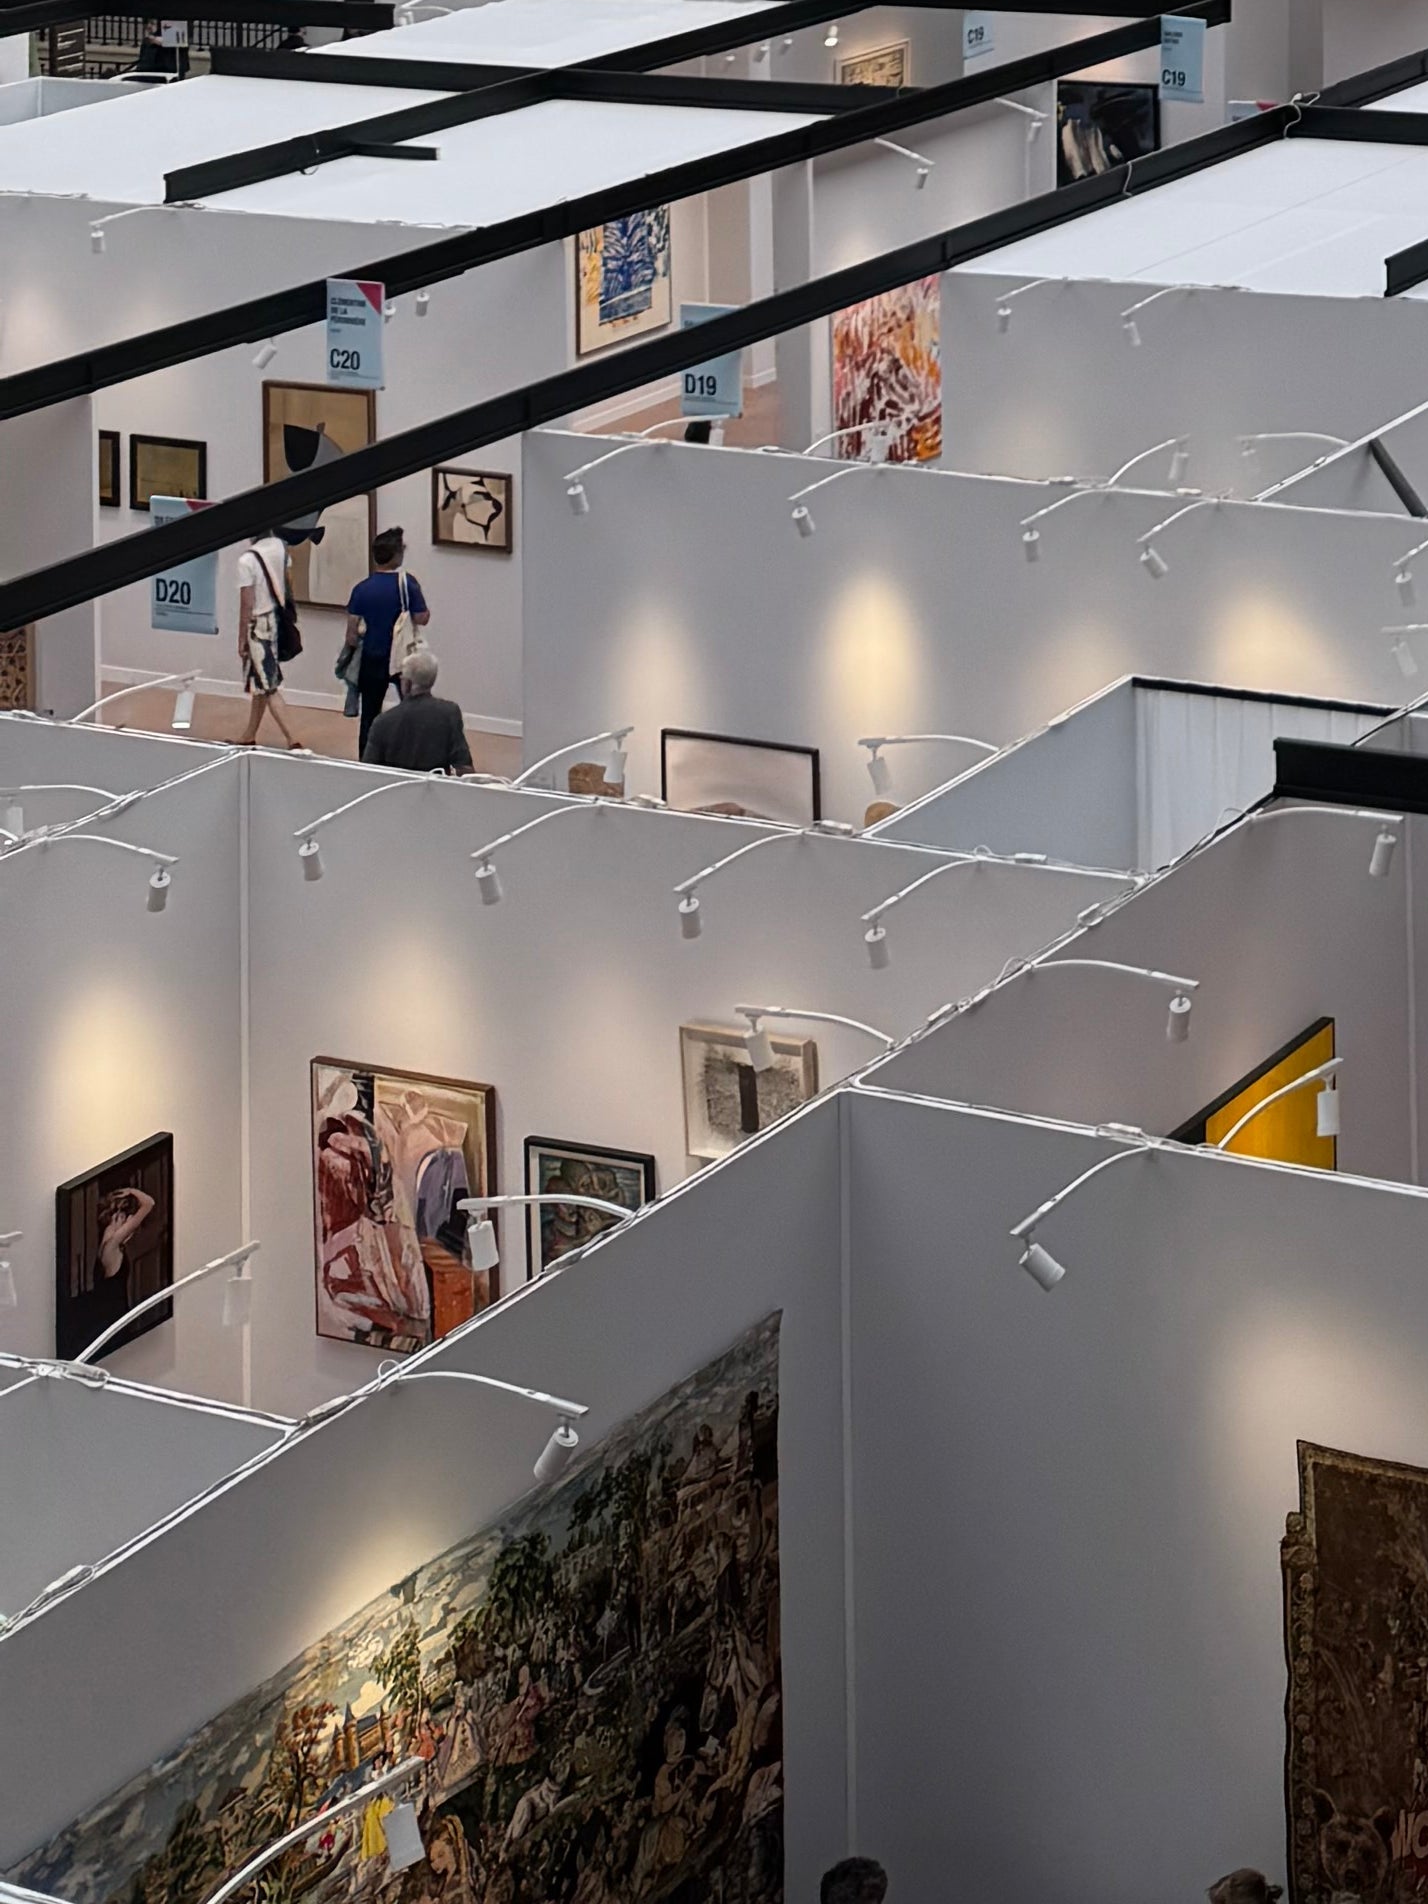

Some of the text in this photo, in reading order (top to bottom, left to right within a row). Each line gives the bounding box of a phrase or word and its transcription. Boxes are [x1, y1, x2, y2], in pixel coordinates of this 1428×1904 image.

[967, 26, 985, 44] C19
[1162, 69, 1186, 86] C19
[330, 348, 361, 370] C20
[684, 373, 718, 396] D19
[155, 577, 192, 605] D20
